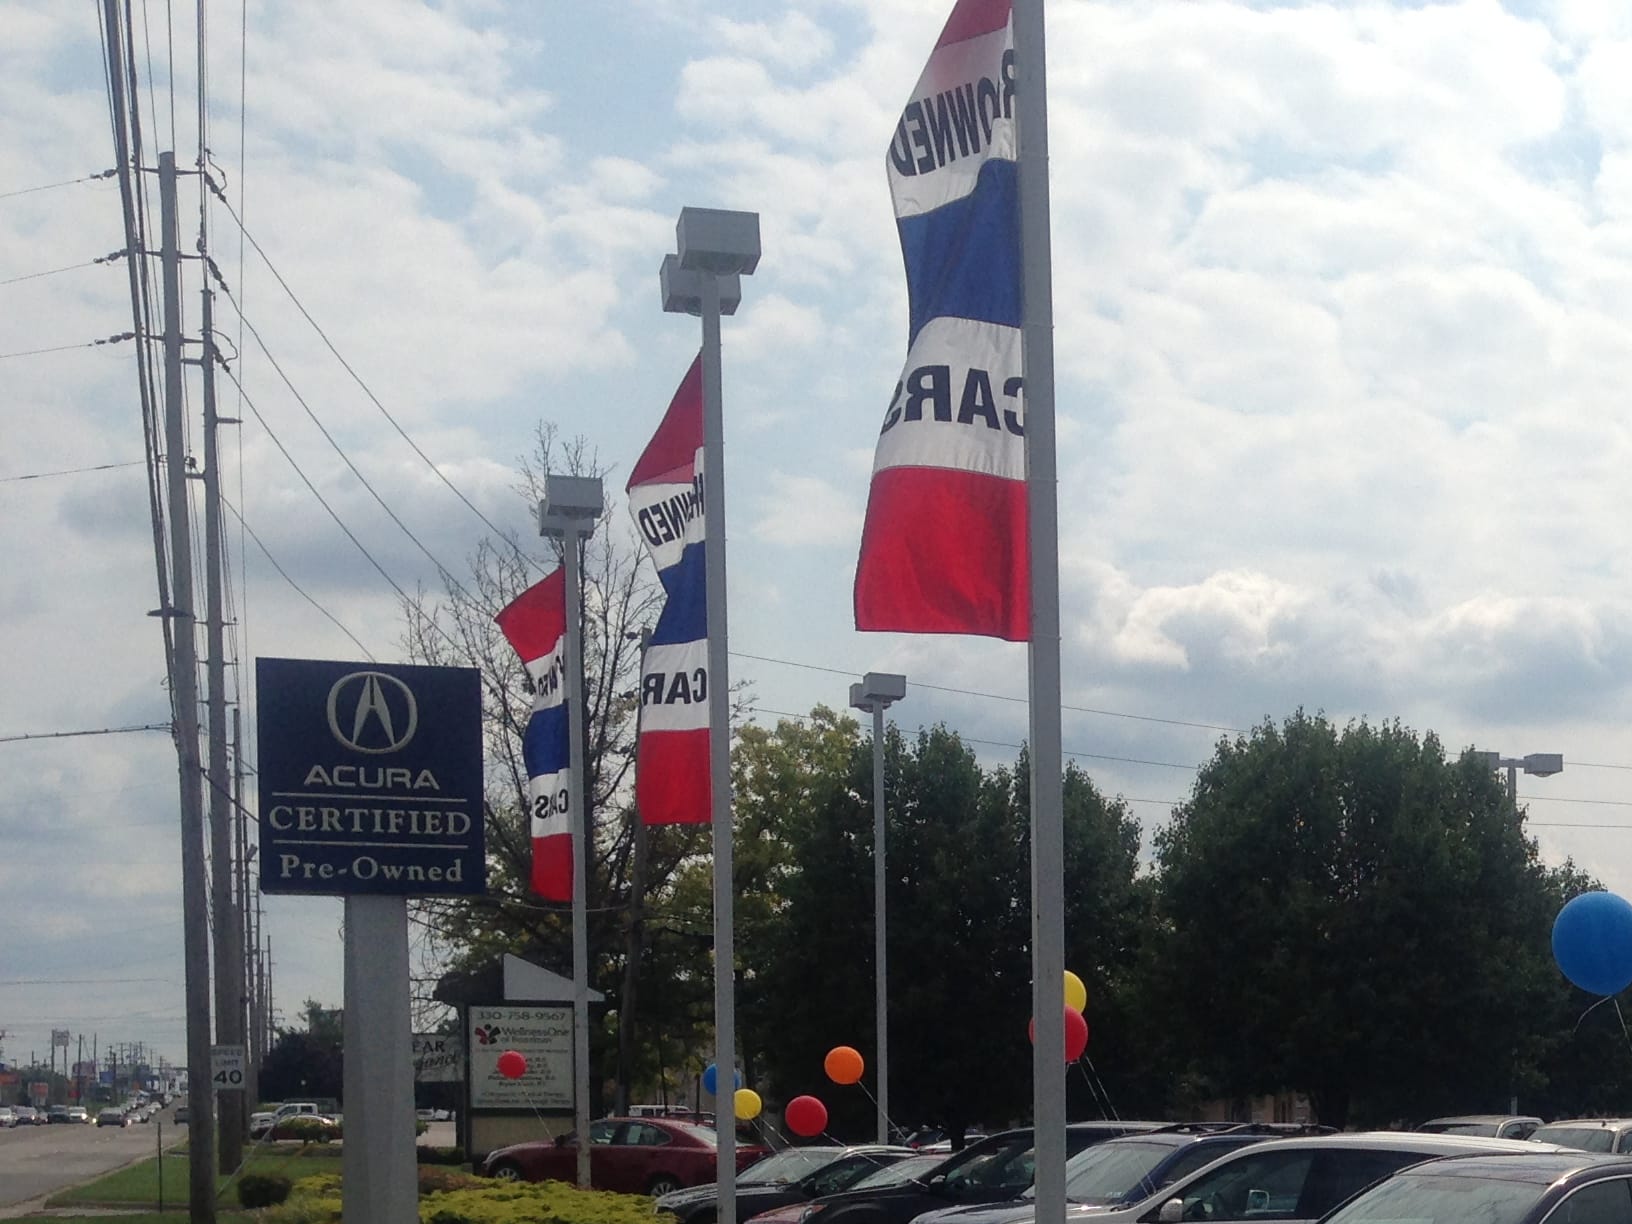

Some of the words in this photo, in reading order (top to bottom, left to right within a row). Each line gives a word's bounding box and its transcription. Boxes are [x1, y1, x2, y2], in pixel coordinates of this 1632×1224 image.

[303, 764, 440, 790] ACURA
[269, 805, 472, 836] CERTIFIED
[279, 854, 464, 882] Pre-Owned
[214, 1070, 242, 1084] 40
